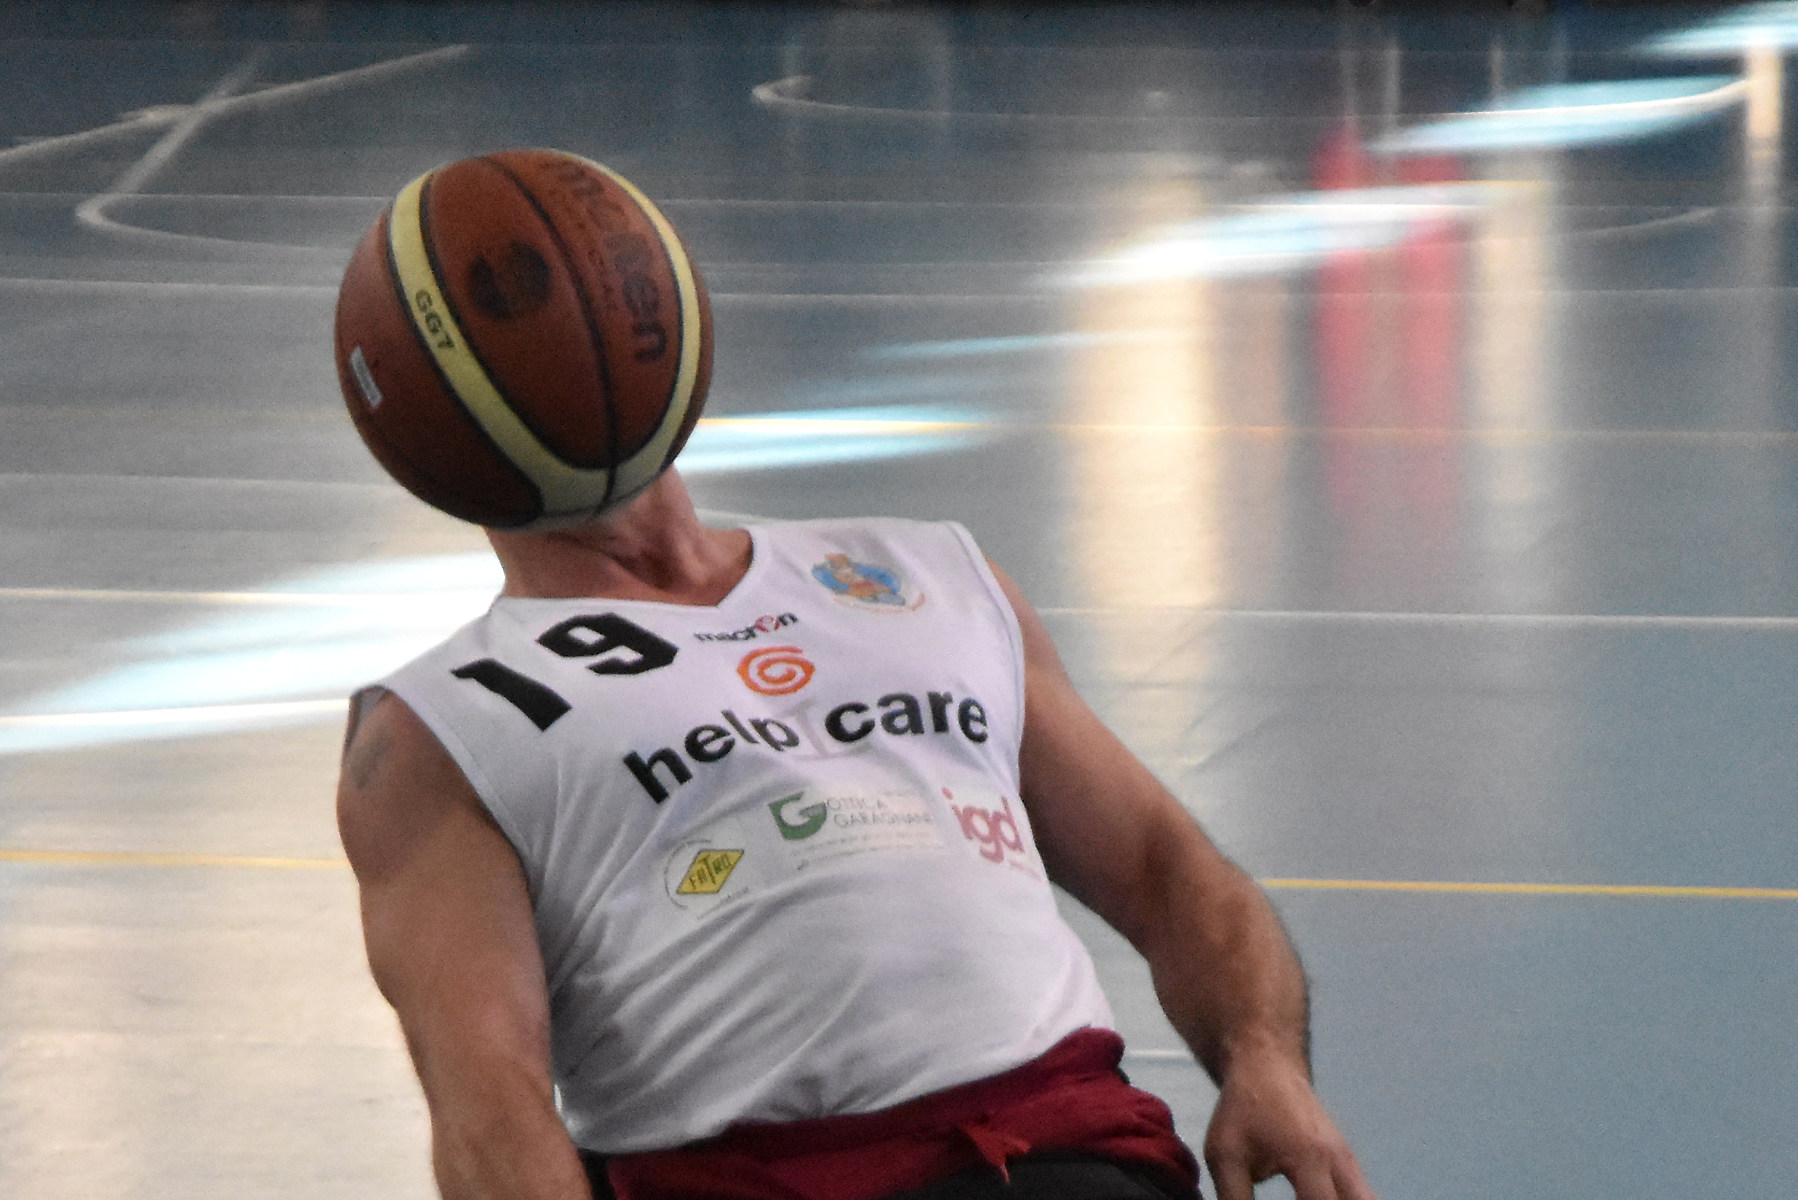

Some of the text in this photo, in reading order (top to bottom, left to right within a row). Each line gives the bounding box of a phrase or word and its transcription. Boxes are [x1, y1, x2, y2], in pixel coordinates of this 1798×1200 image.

[451, 613, 679, 732] 19
[693, 611, 798, 642] macron
[623, 690, 988, 803] help care
[941, 786, 1026, 864] igd
